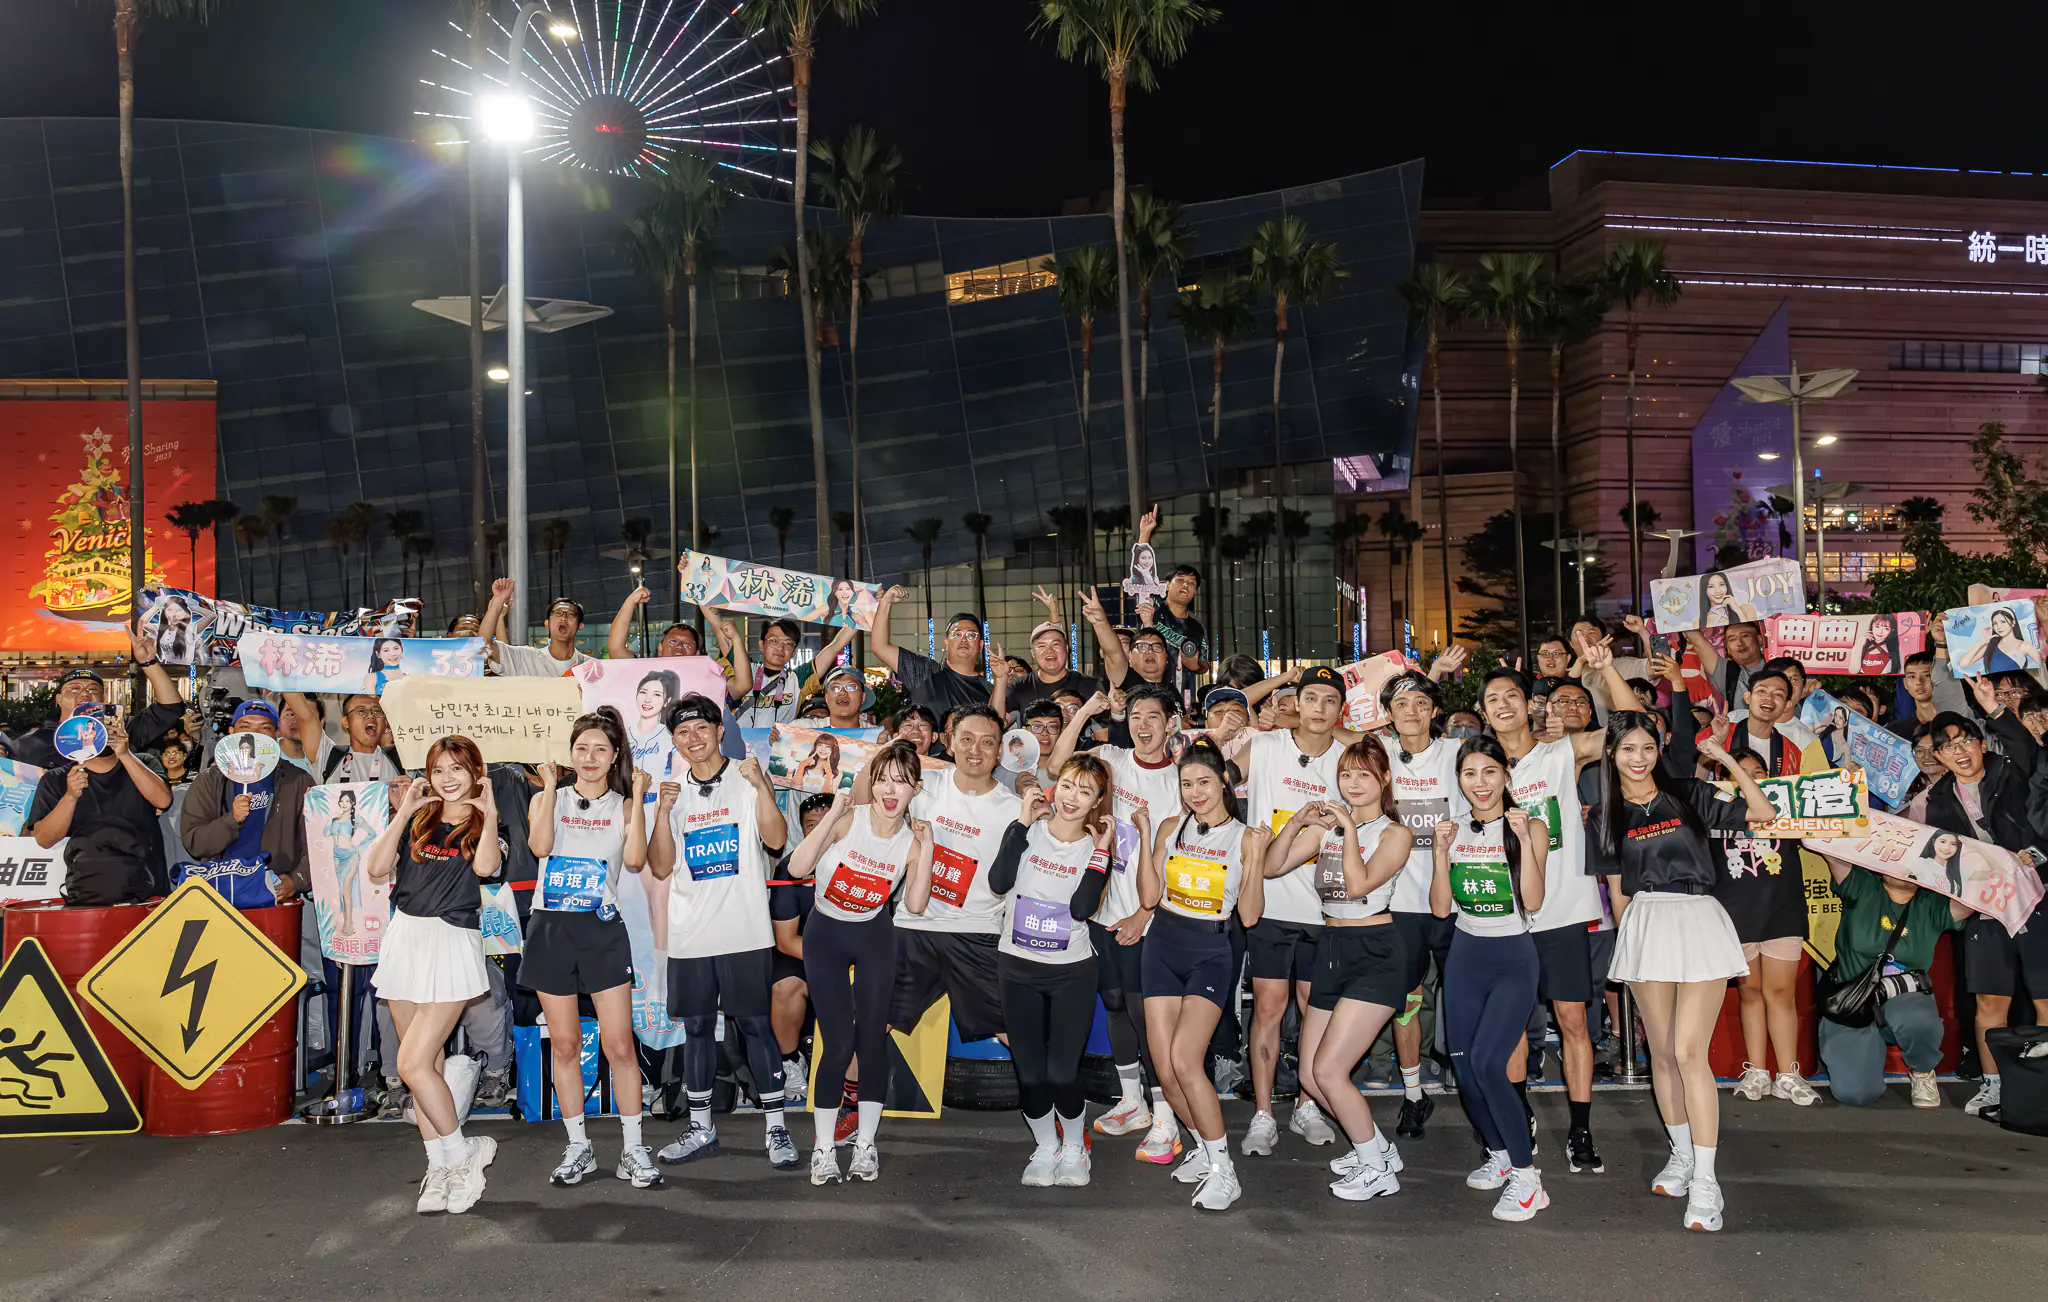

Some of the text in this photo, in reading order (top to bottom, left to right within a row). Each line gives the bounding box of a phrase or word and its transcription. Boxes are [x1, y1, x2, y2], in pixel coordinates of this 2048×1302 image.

[1968, 231, 2048, 265] 統一時
[144, 441, 179, 455] Sharing
[685, 582, 706, 600] 33
[740, 568, 815, 608] 林浠
[1747, 571, 1793, 602] JOY
[259, 638, 343, 678] 林浠
[429, 648, 477, 678] 33
[1782, 650, 1847, 662] CHU CHU
[430, 703, 578, 722] 남민정 최고! 내 마음
[467, 724, 515, 738] 언제나
[1840, 768, 1863, 784] 07
[1878, 779, 1901, 799] 98
[1401, 813, 1444, 828] YORK
[1848, 815, 1919, 863] 浠
[687, 839, 738, 858] TRAVIS
[706, 863, 733, 873] 0012
[548, 871, 601, 890] 南珉貞
[1462, 878, 1497, 895] 林浠
[931, 885, 957, 901] 0012
[1979, 870, 2017, 913] 33
[562, 897, 592, 906] 0012
[843, 901, 871, 912] 0012
[1185, 897, 1212, 908] 0012
[1474, 904, 1504, 912] 0012
[1030, 939, 1059, 948] 0012
